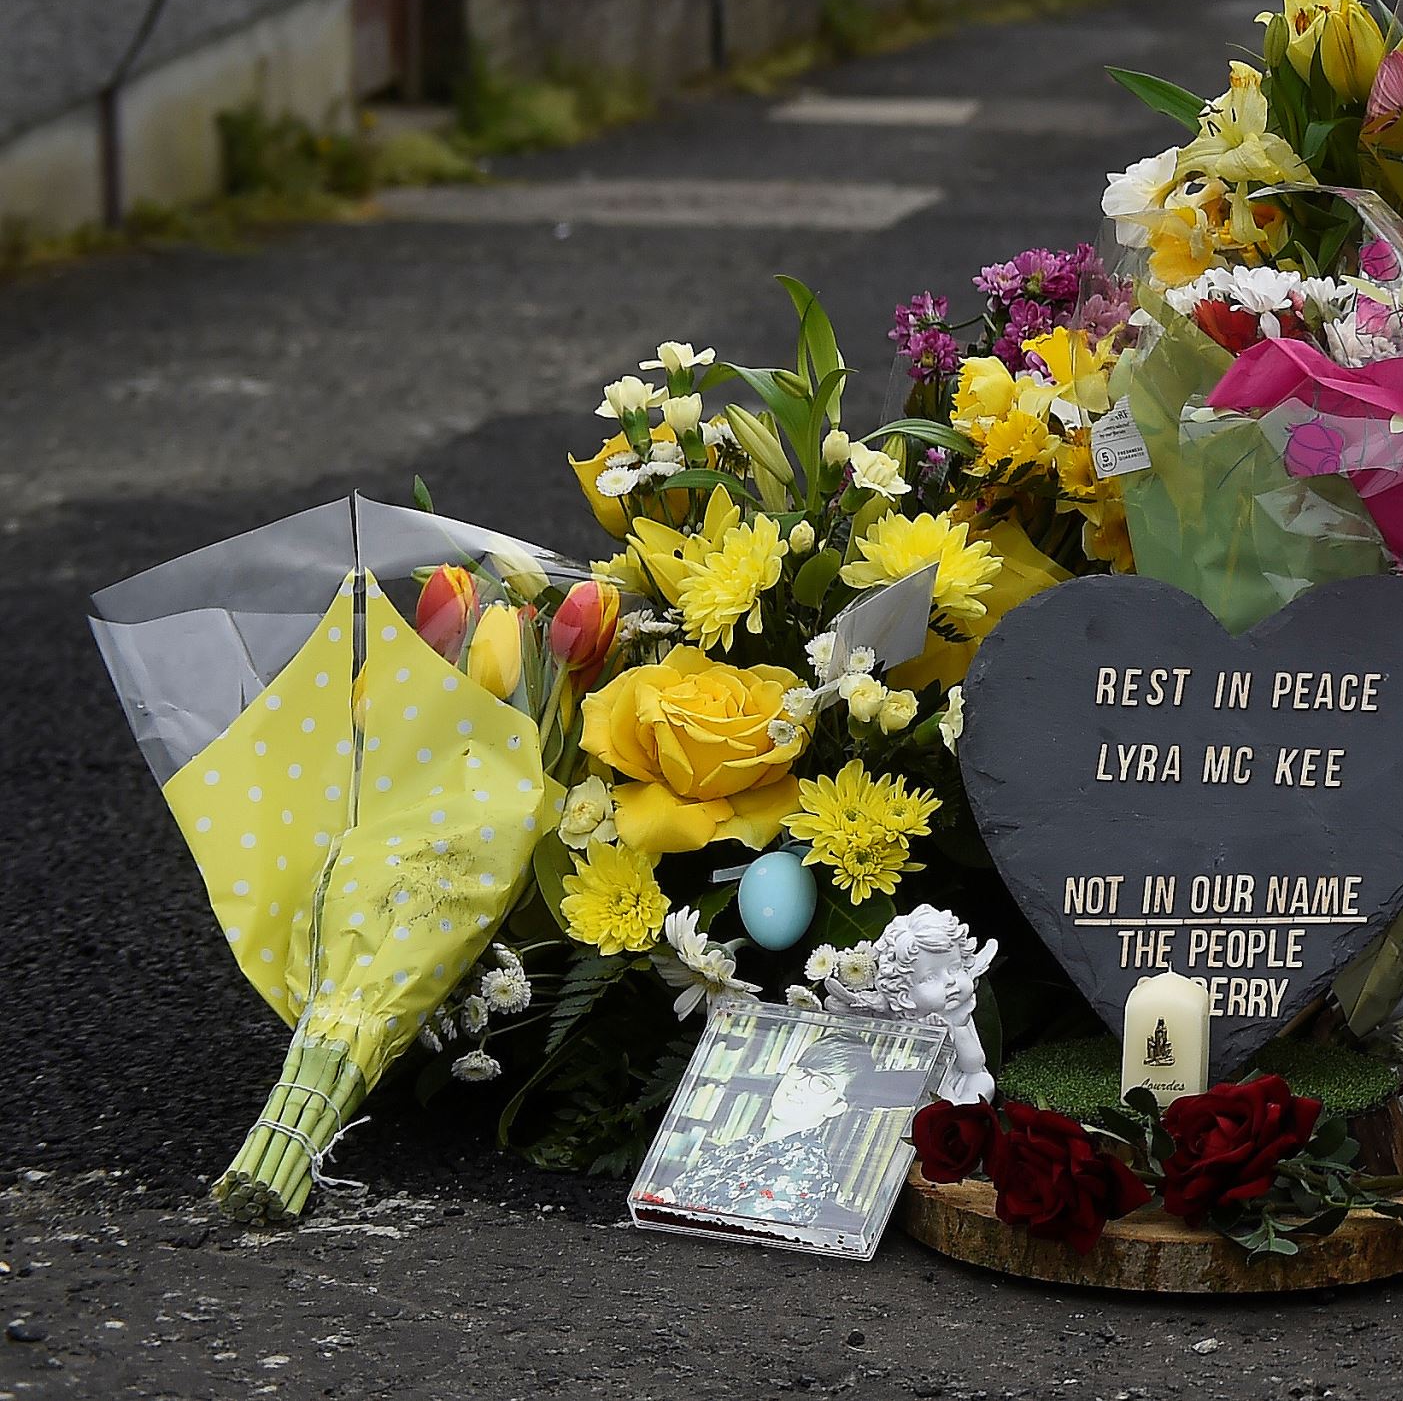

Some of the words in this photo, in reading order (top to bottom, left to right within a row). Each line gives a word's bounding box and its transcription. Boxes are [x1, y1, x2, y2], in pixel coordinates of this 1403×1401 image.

[1101, 451, 1110, 463] 5
[1096, 667, 1191, 707] REST
[1213, 671, 1253, 709] IN
[1270, 672, 1382, 712] PEACE
[1096, 743, 1182, 783] LYRA
[1202, 746, 1254, 785] MC
[1274, 748, 1346, 788] KEE
[1064, 875, 1124, 915] NOT
[1141, 876, 1177, 915] IN
[1190, 875, 1255, 915] OUR
[1265, 876, 1363, 916] NAME
[1118, 930, 1175, 969] THE
[1188, 929, 1306, 969] PEOPLE
[1190, 976, 1290, 1017] ERRY
